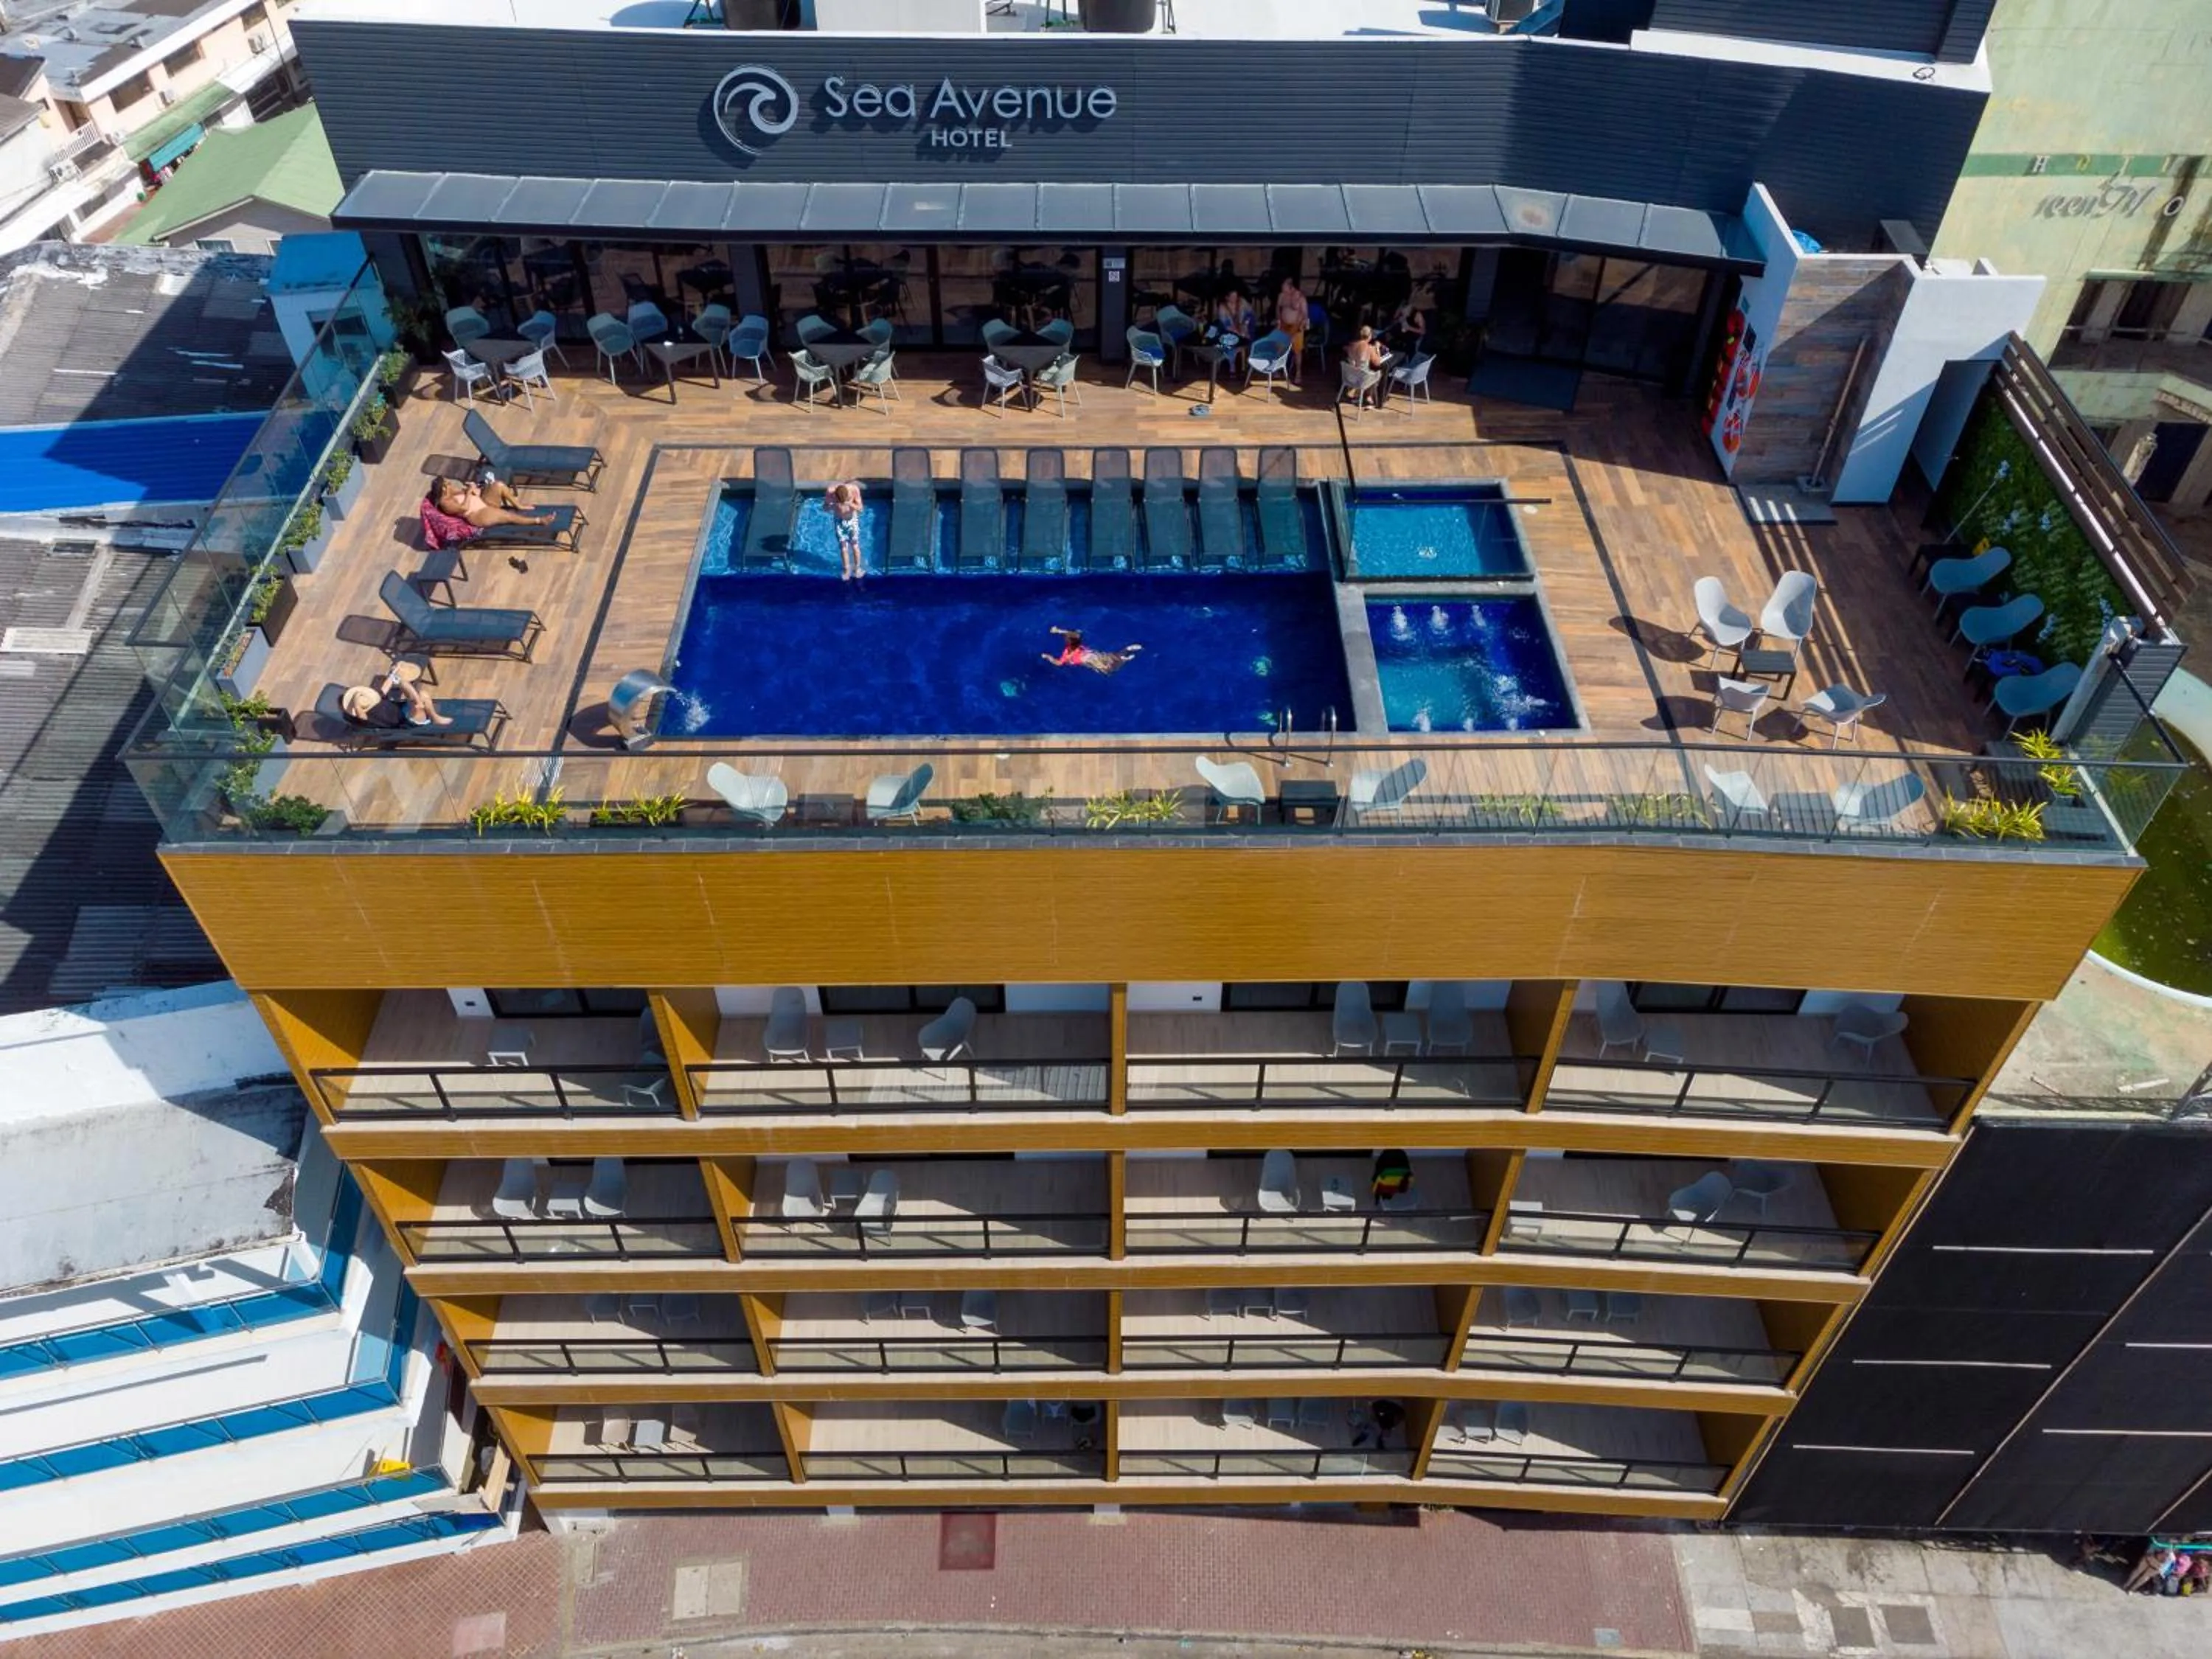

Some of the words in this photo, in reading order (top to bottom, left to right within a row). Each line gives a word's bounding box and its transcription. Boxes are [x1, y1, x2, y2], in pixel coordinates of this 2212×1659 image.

[824, 76, 917, 117] Sea
[930, 77, 1117, 119] Avenue
[931, 128, 1013, 147] HOTEL
